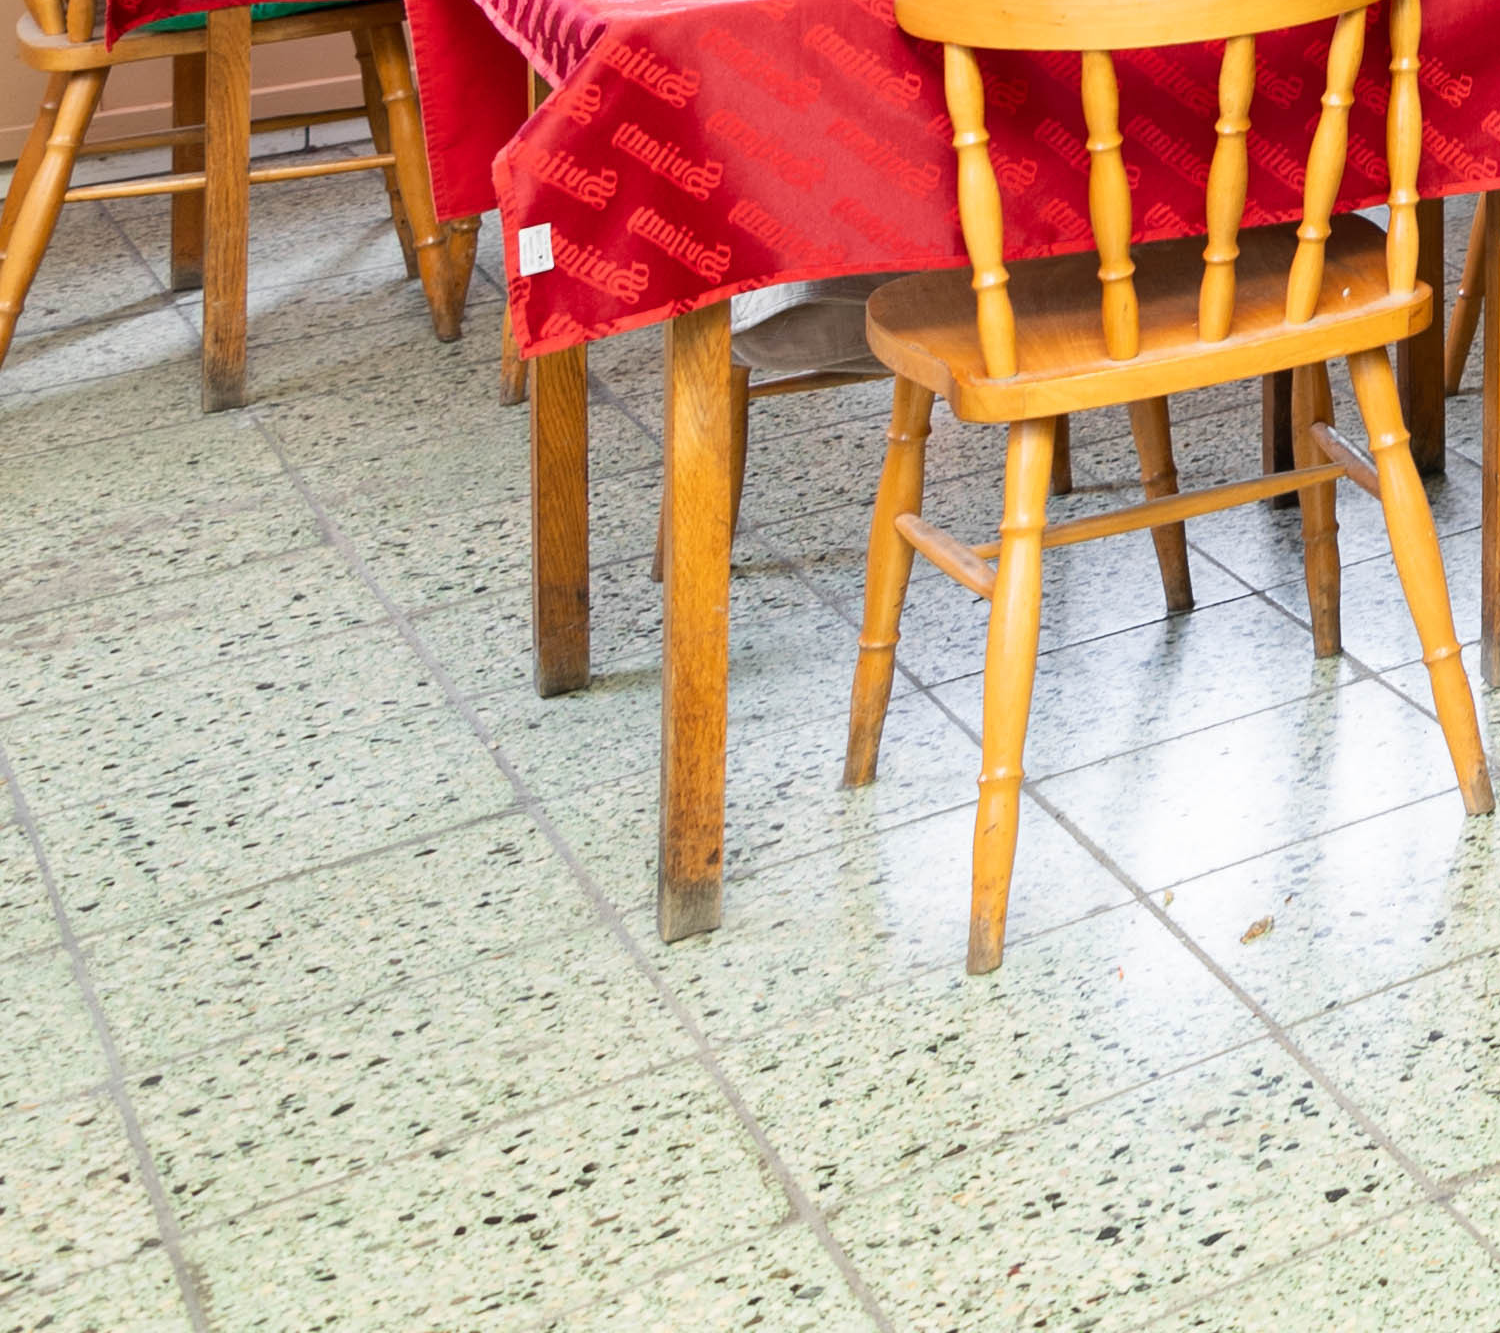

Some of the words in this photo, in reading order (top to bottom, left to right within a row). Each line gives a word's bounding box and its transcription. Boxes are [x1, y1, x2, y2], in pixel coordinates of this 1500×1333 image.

[803, 24, 922, 110] Svijany
[612, 122, 723, 202] Svijany
[627, 206, 731, 284] Svijany
